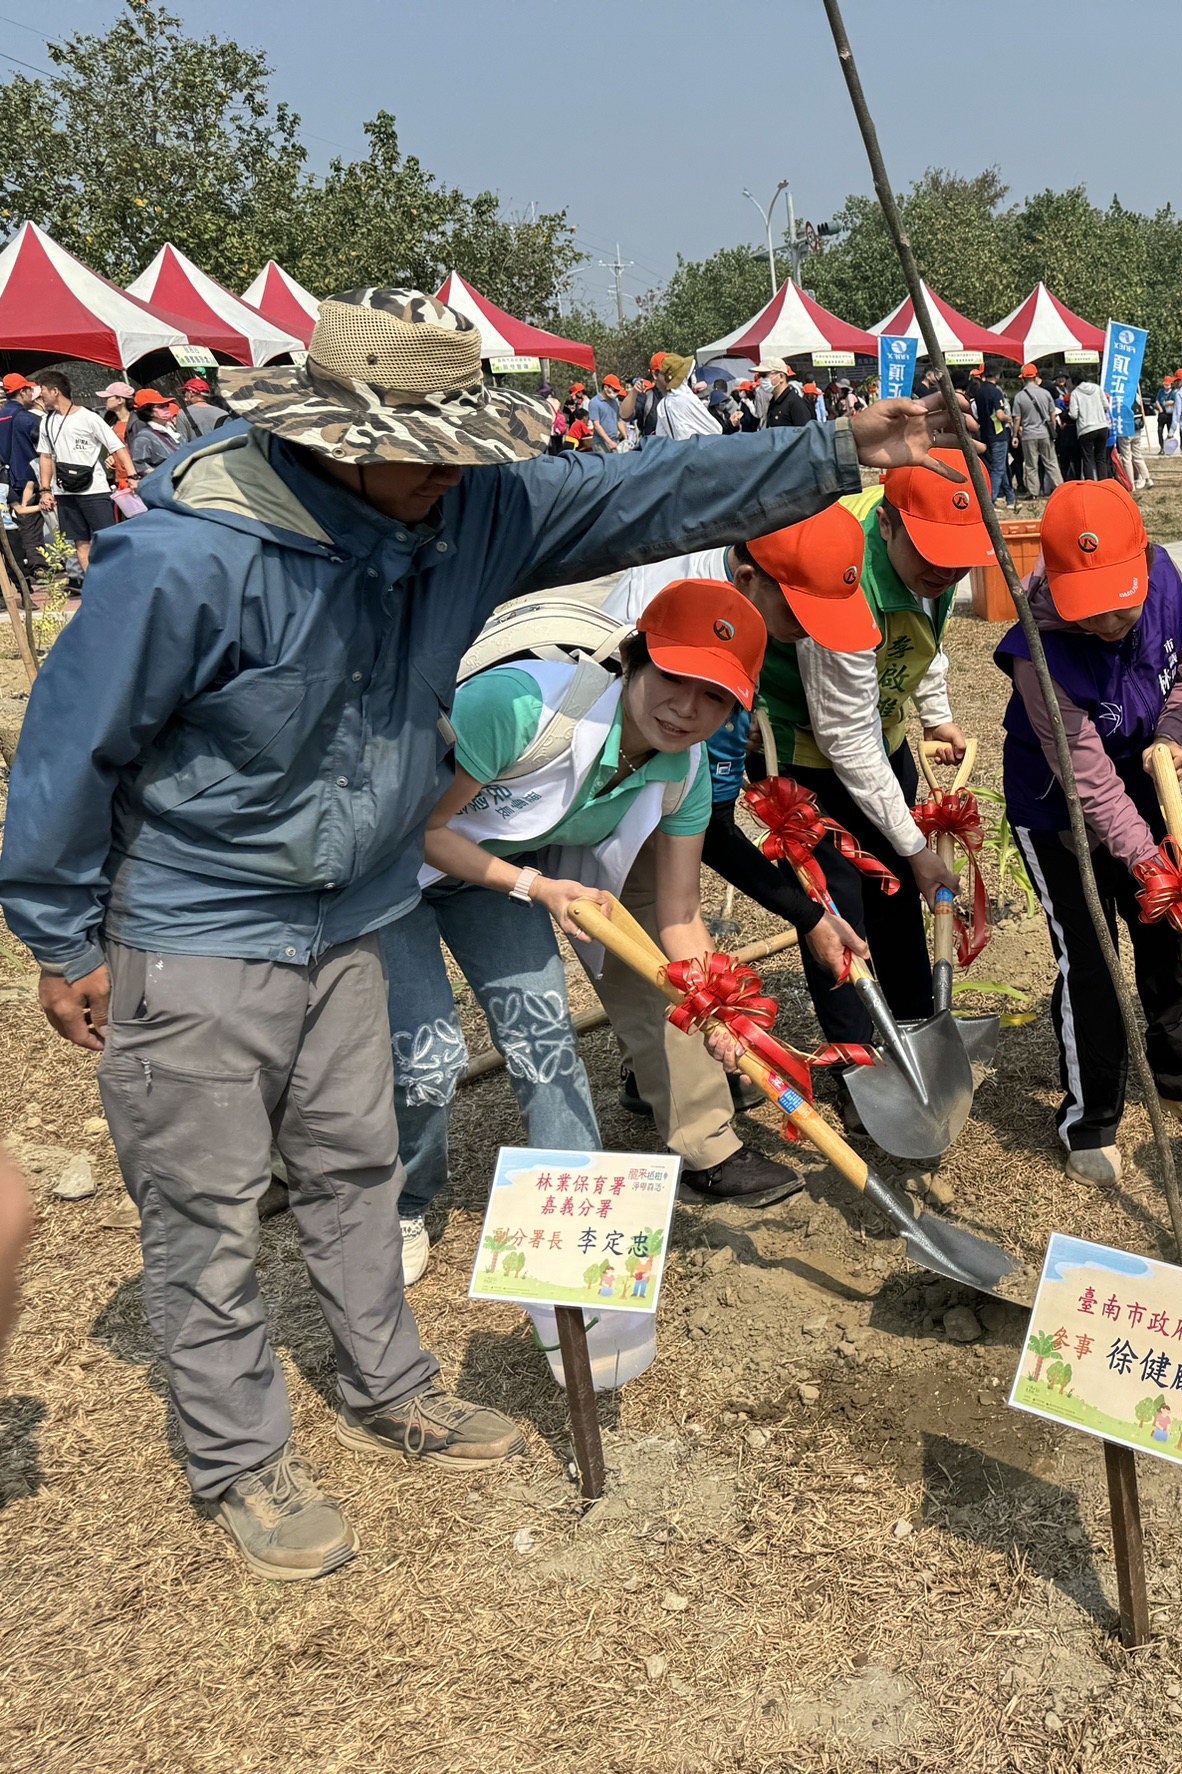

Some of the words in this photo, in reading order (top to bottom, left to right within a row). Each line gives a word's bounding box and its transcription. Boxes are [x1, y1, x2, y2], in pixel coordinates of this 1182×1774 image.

[535, 1172, 626, 1197] 林業保育署
[540, 1195, 613, 1219] 嘉義分署
[493, 1227, 563, 1251] 副分署長
[577, 1226, 650, 1258] 李定忠
